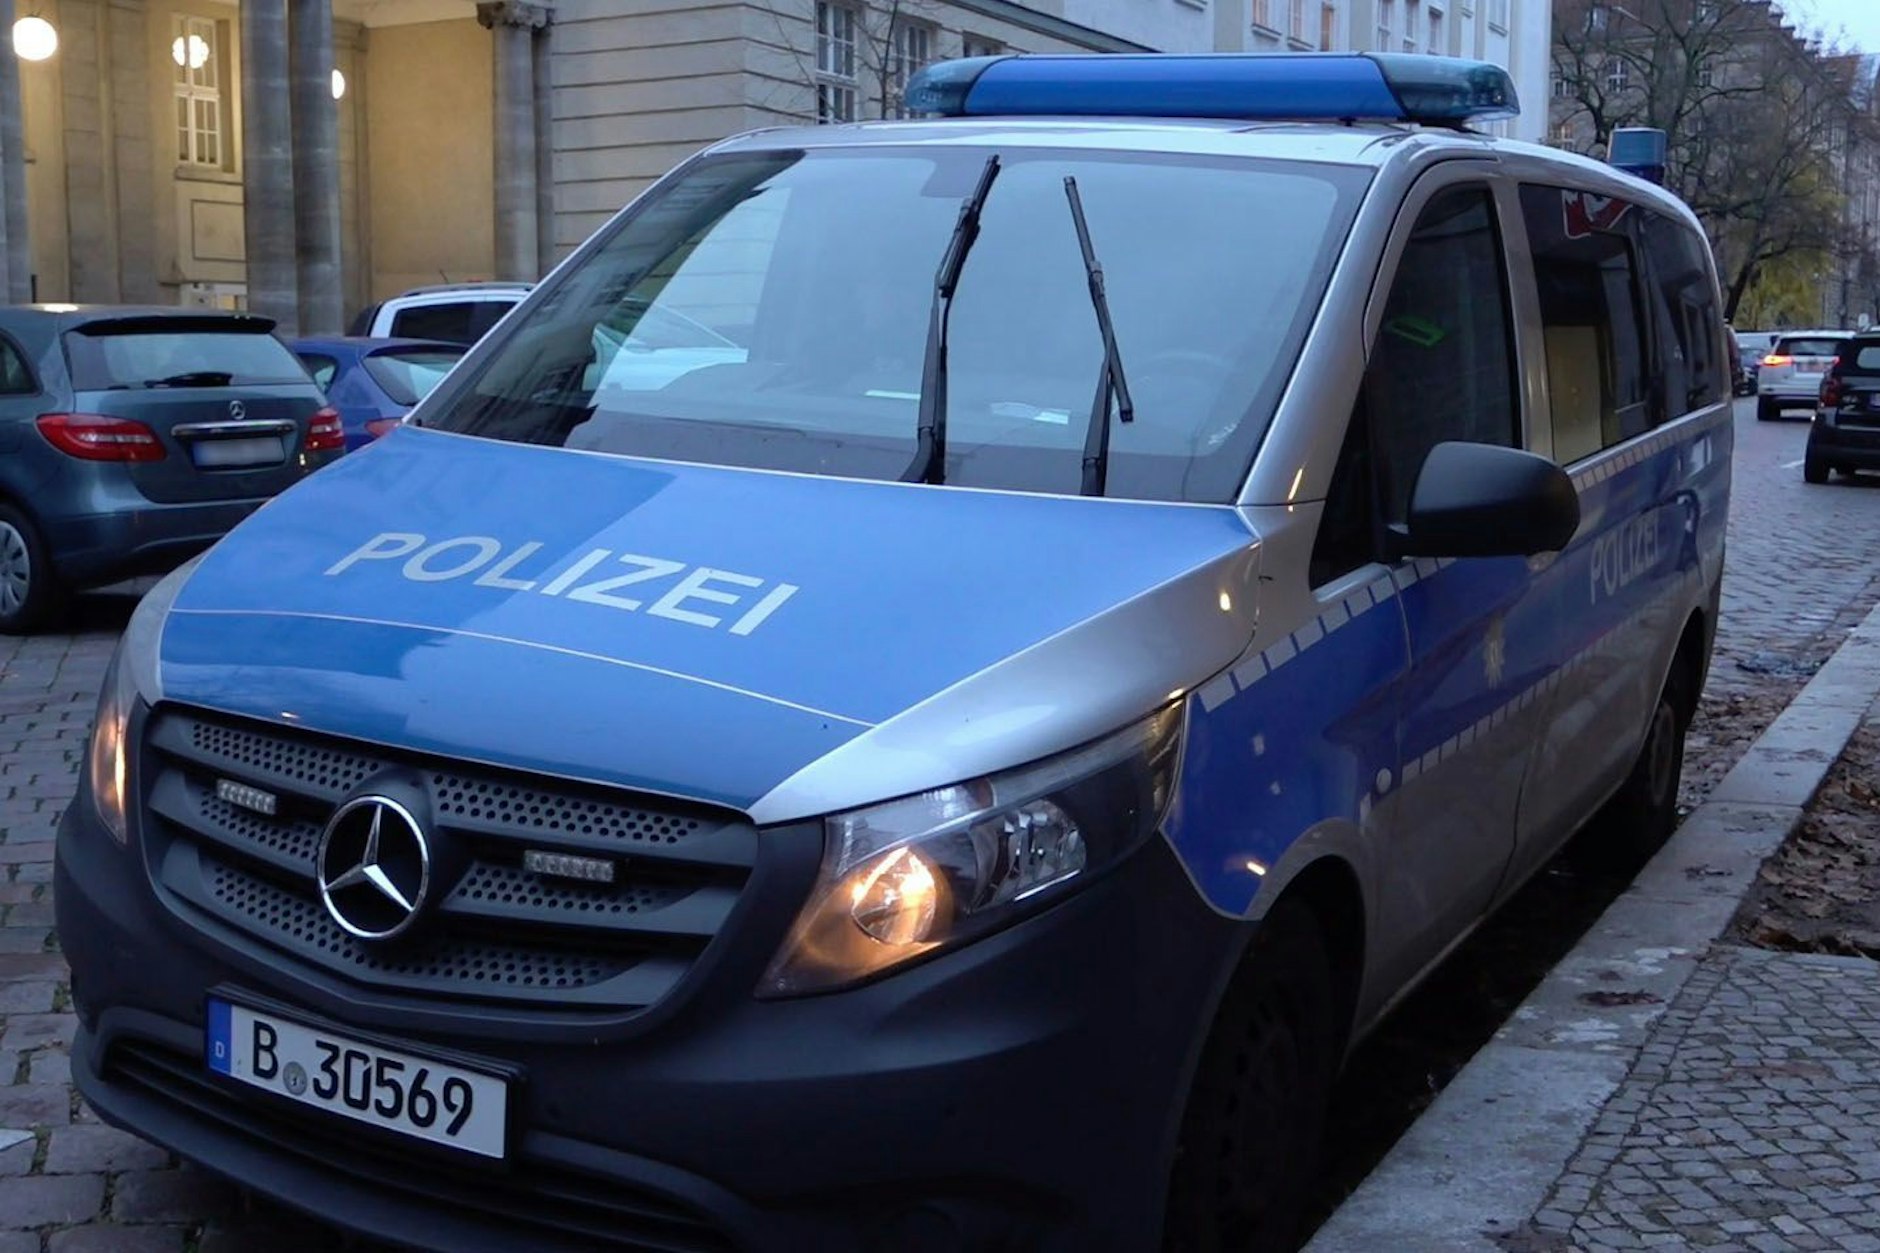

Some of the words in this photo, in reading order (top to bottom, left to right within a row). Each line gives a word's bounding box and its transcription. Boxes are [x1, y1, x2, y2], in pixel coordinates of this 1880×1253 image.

[323, 532, 800, 637] POLIZEI
[1590, 510, 1659, 606] POLIZEI
[215, 1041, 225, 1058] D
[253, 1020, 279, 1079] B
[313, 1039, 473, 1137] 30569
